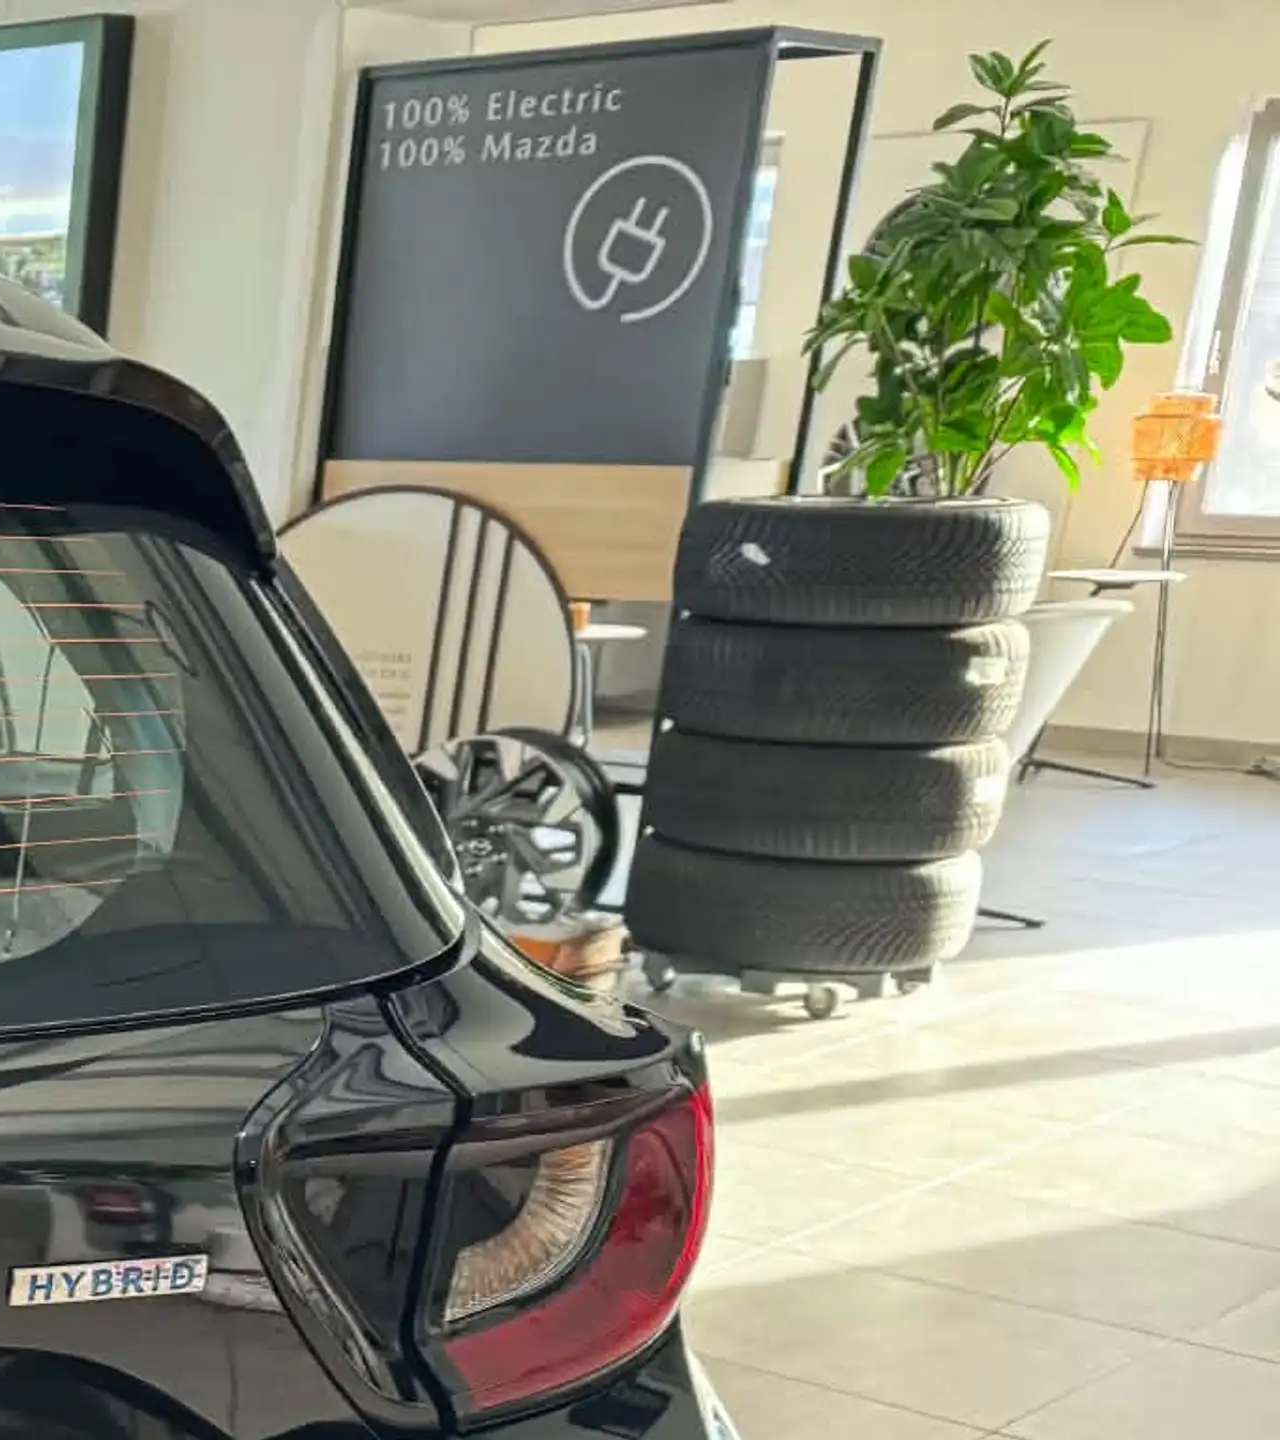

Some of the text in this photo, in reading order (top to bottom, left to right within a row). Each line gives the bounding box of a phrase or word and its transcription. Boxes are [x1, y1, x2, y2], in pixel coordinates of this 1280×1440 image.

[383, 82, 624, 131] 100% Electric
[380, 124, 598, 171] 100% Mazda
[26, 1262, 196, 1301] HYBRID
